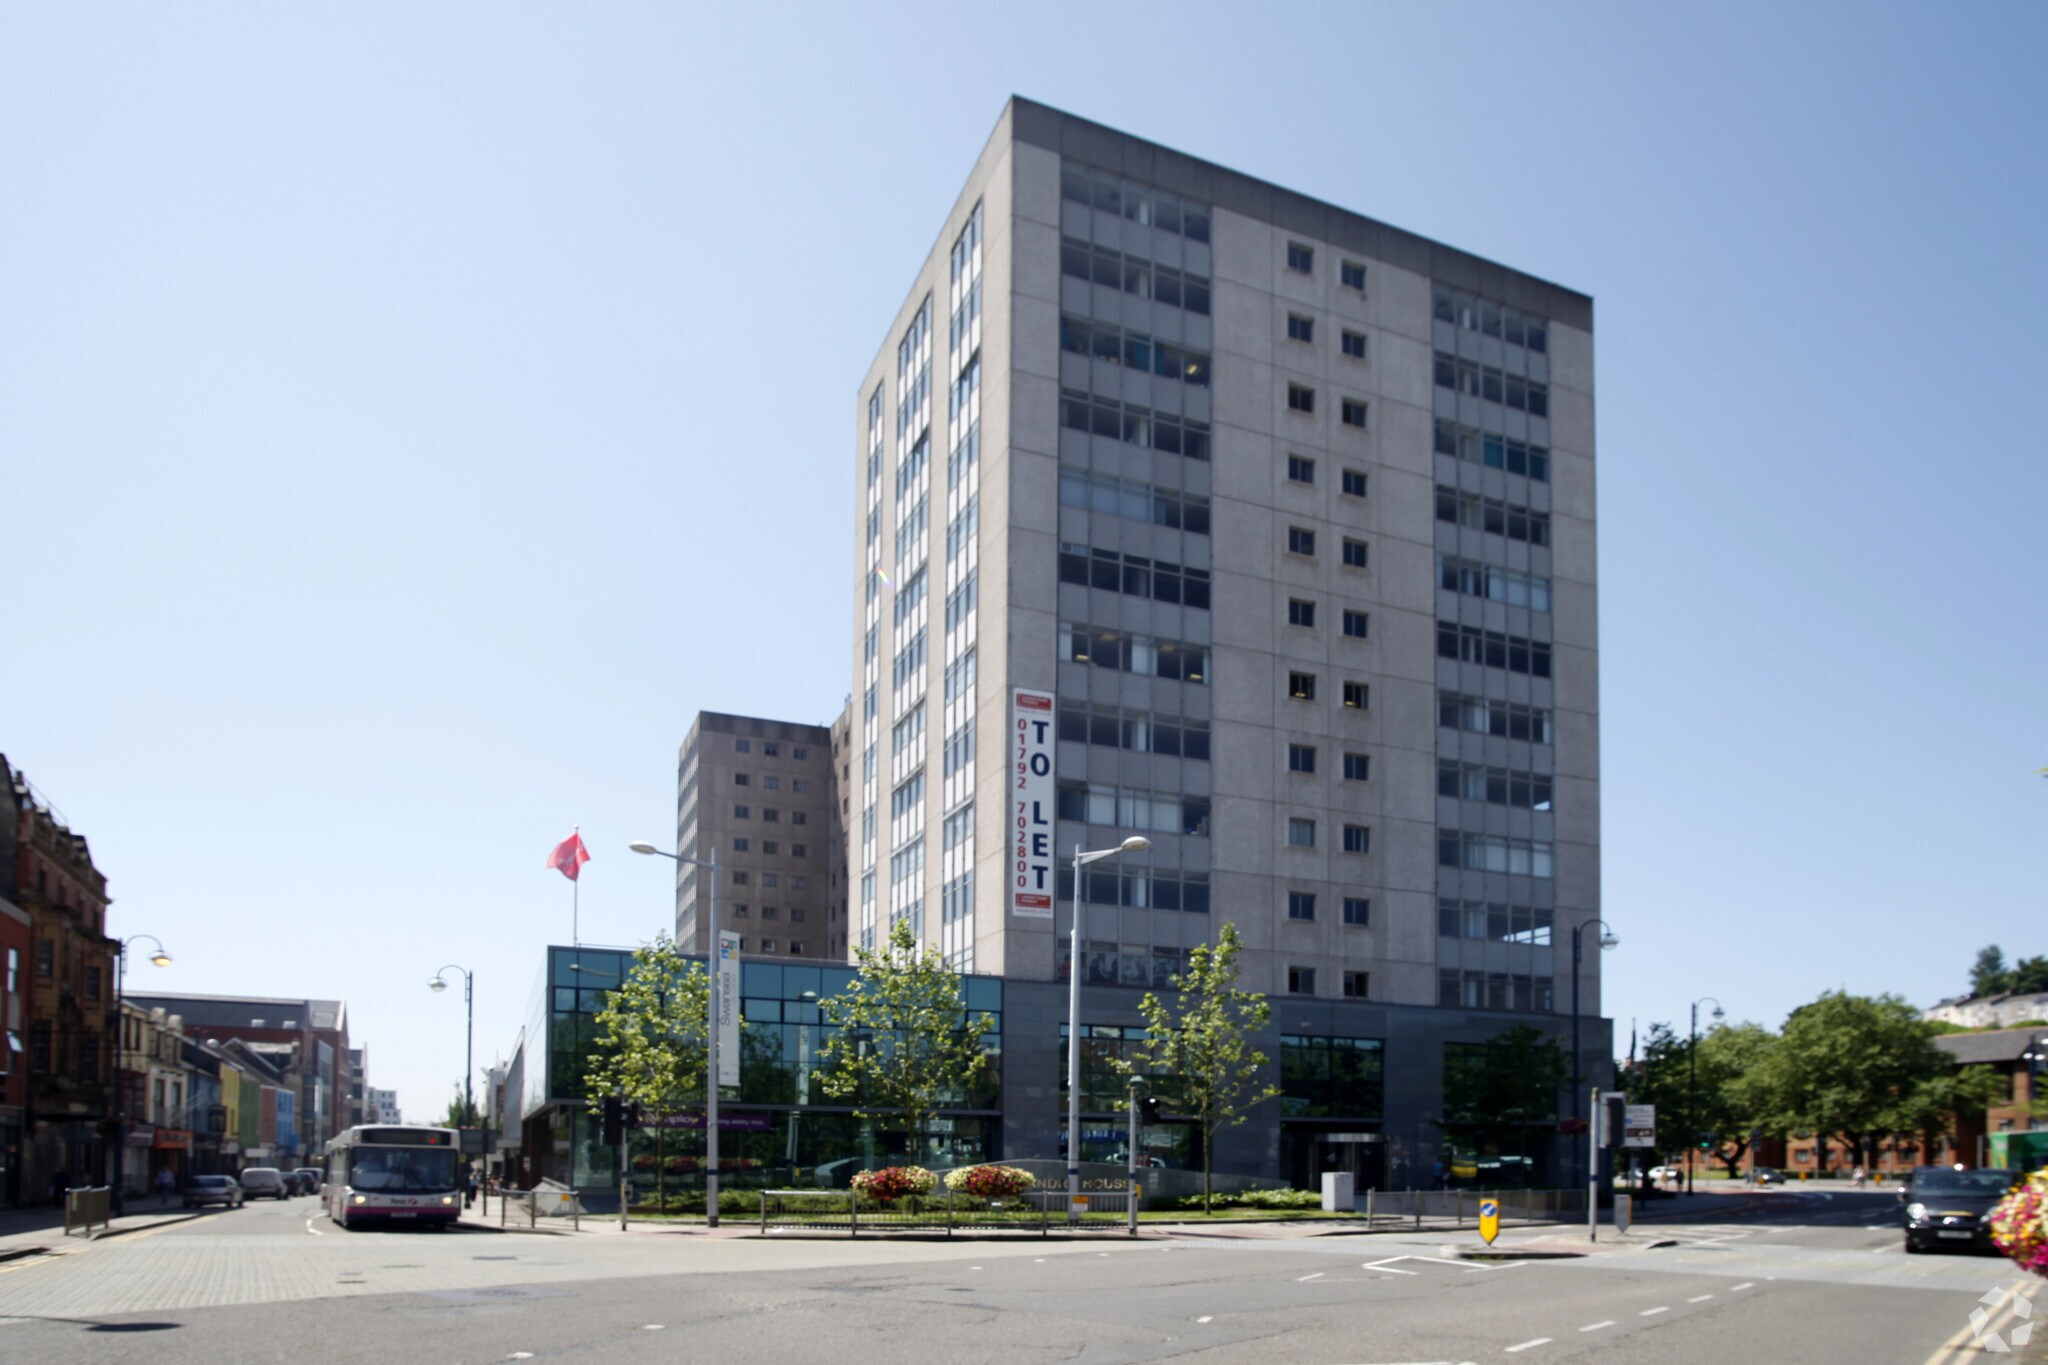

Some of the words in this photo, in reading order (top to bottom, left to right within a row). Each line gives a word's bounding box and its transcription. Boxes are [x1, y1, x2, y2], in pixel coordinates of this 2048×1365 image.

[1017, 718, 1027, 790] 01792
[1030, 720, 1050, 777] TO
[1017, 801, 1027, 888] 702800
[1031, 800, 1049, 889] LET
[720, 972, 731, 1027] Swansea
